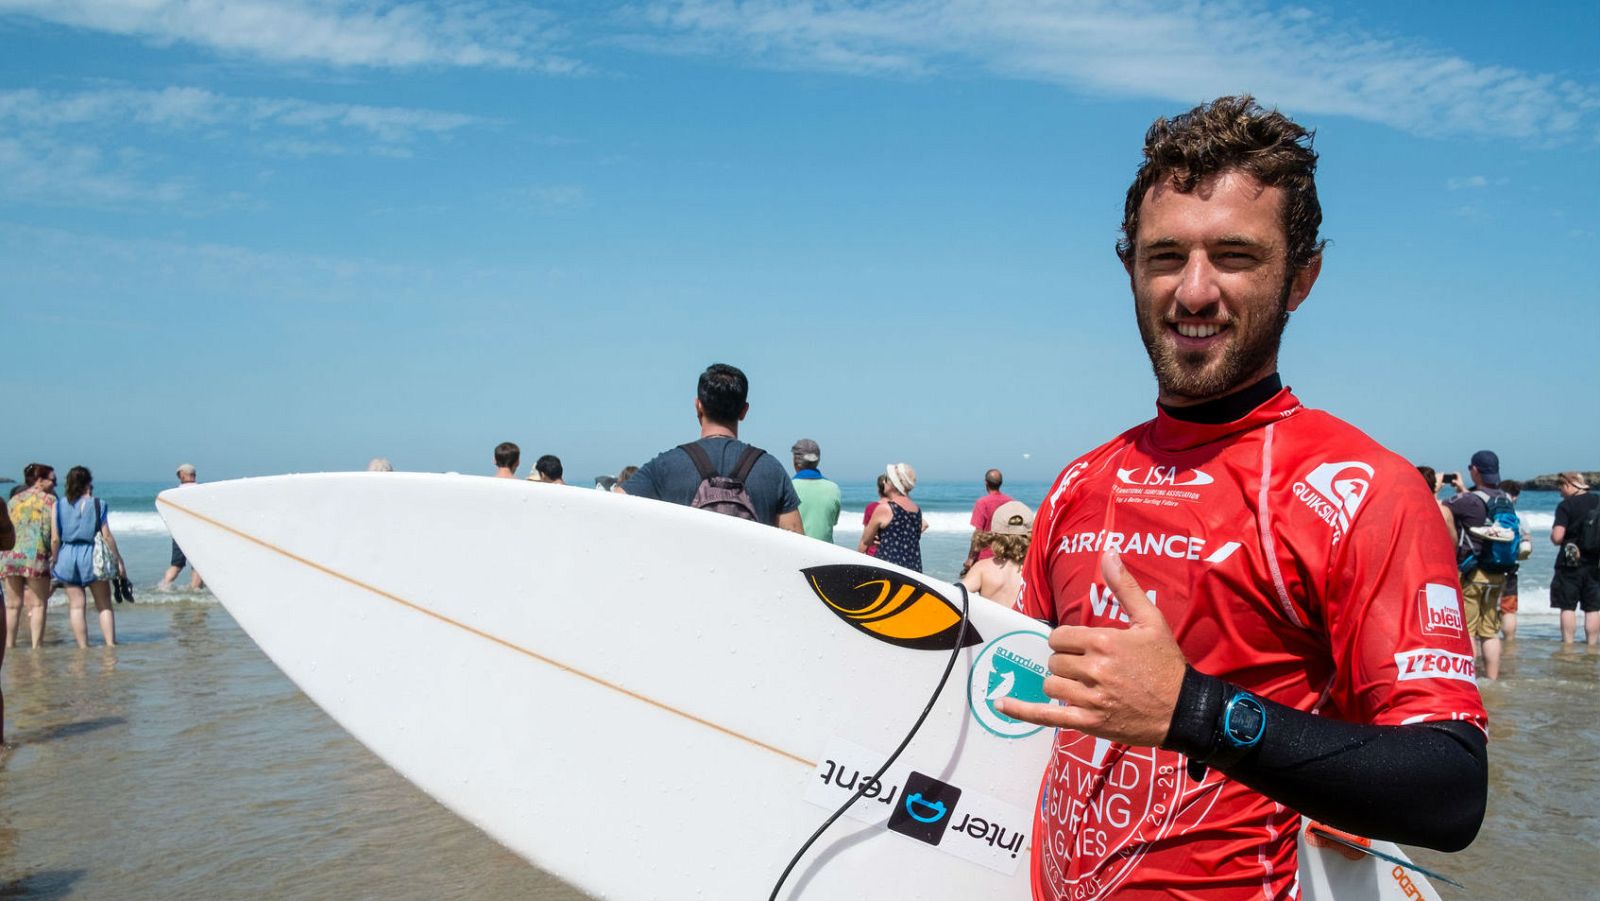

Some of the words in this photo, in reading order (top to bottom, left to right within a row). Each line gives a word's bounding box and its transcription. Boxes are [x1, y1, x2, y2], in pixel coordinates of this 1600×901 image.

[1143, 465, 1176, 486] ISA
[1430, 608, 1461, 629] bleu
[820, 759, 898, 805] rent
[951, 813, 1025, 859] inter
